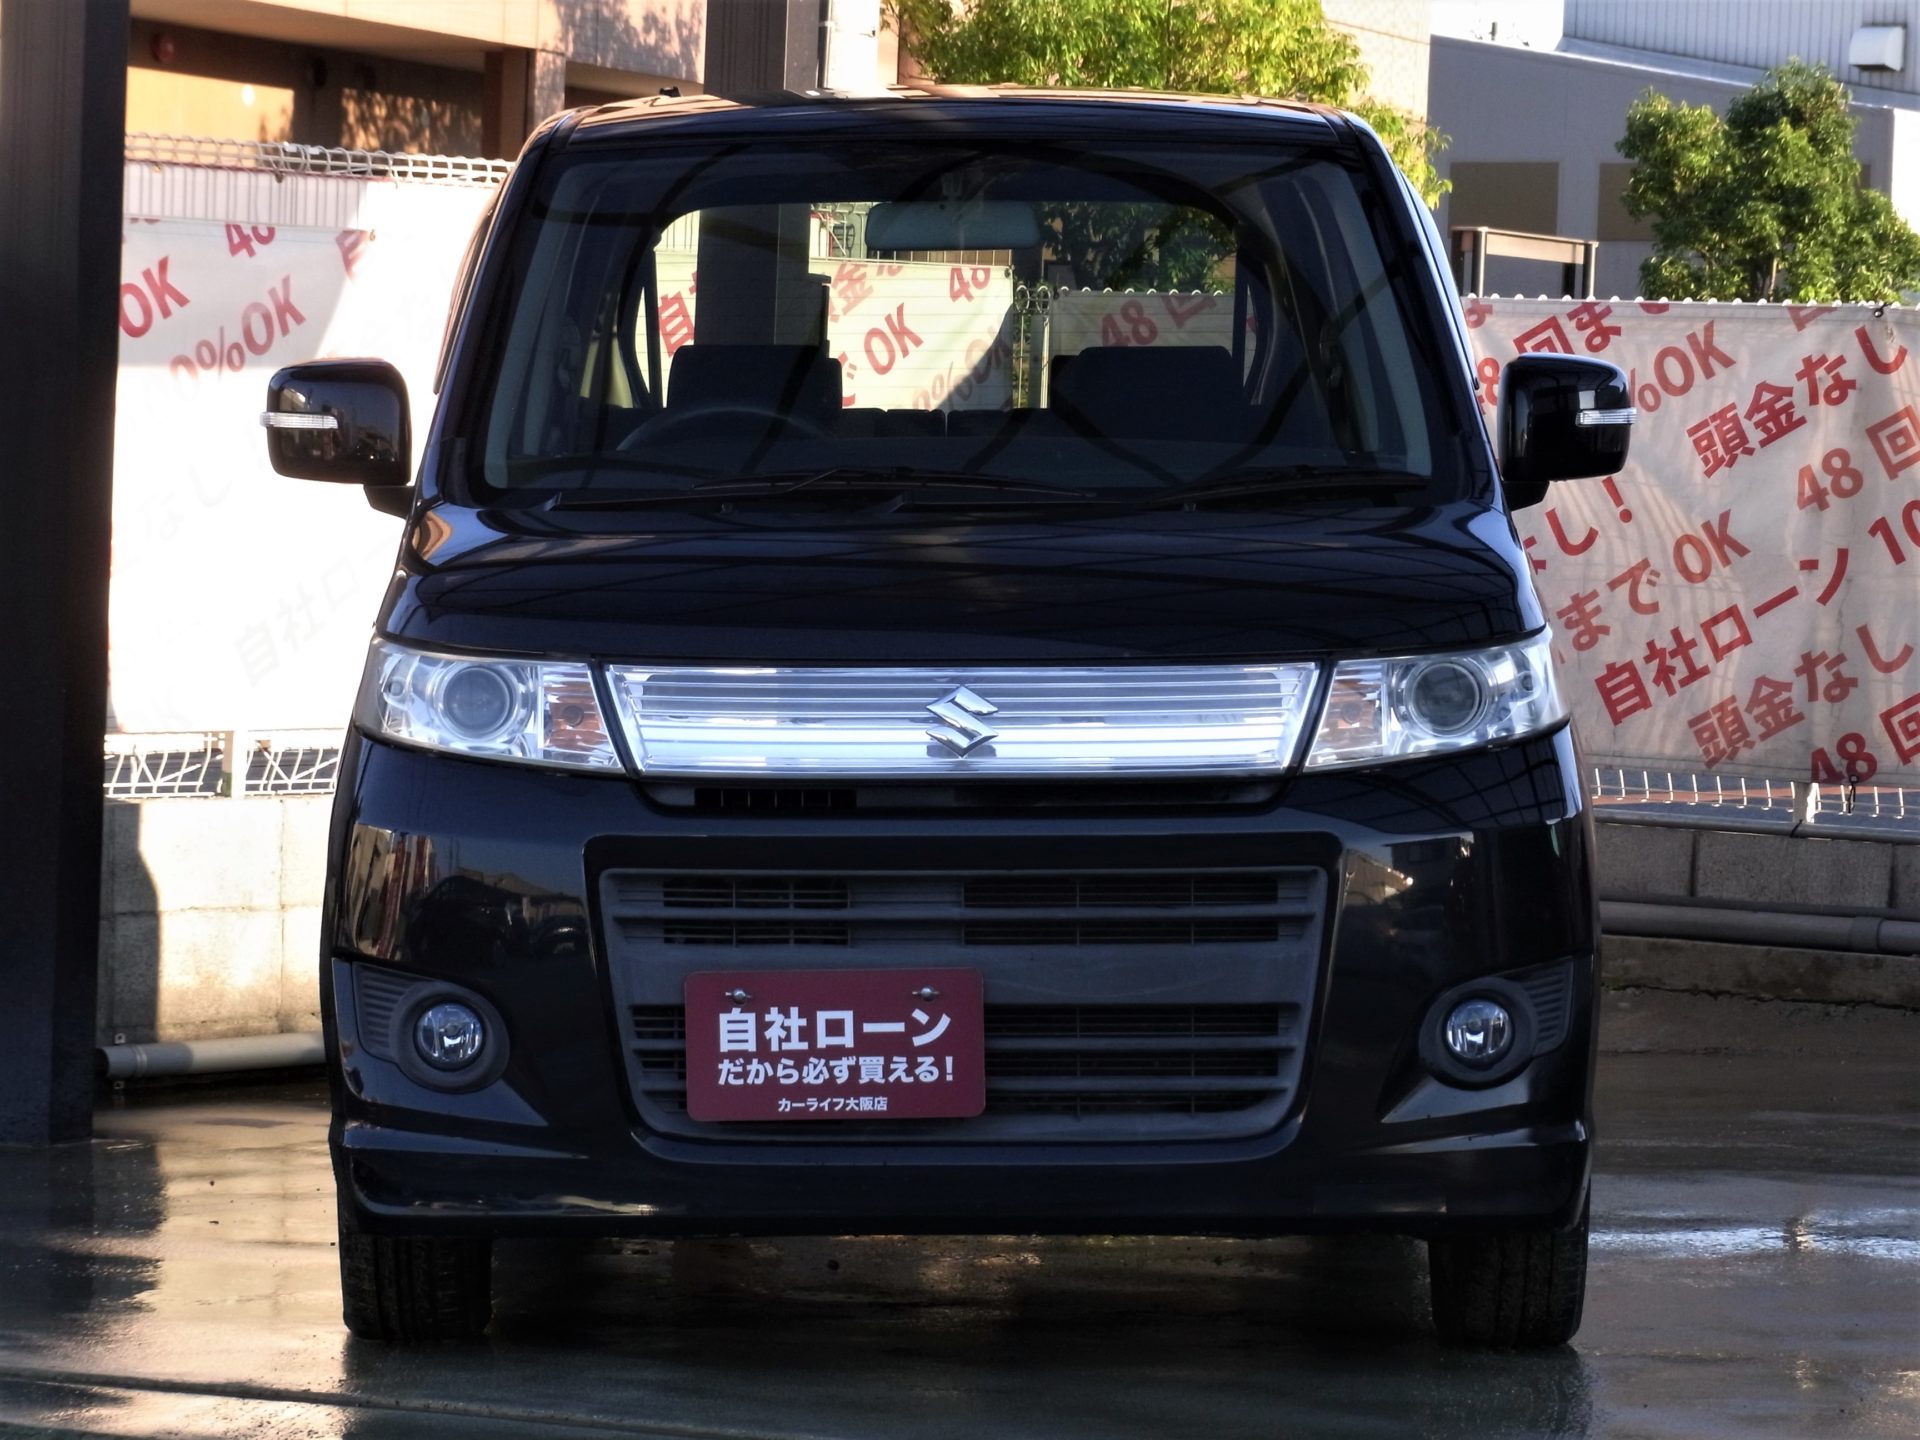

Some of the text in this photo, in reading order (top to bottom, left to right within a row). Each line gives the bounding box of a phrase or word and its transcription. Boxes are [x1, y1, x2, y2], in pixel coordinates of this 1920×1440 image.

[1686, 325, 1908, 478] 頭金なし
[1688, 624, 1914, 769] 頭金なし
[718, 1006, 952, 1052] 自社ローン
[718, 1055, 954, 1085] だから必ず買える！
[778, 1095, 888, 1112] カーライフ大阪店
